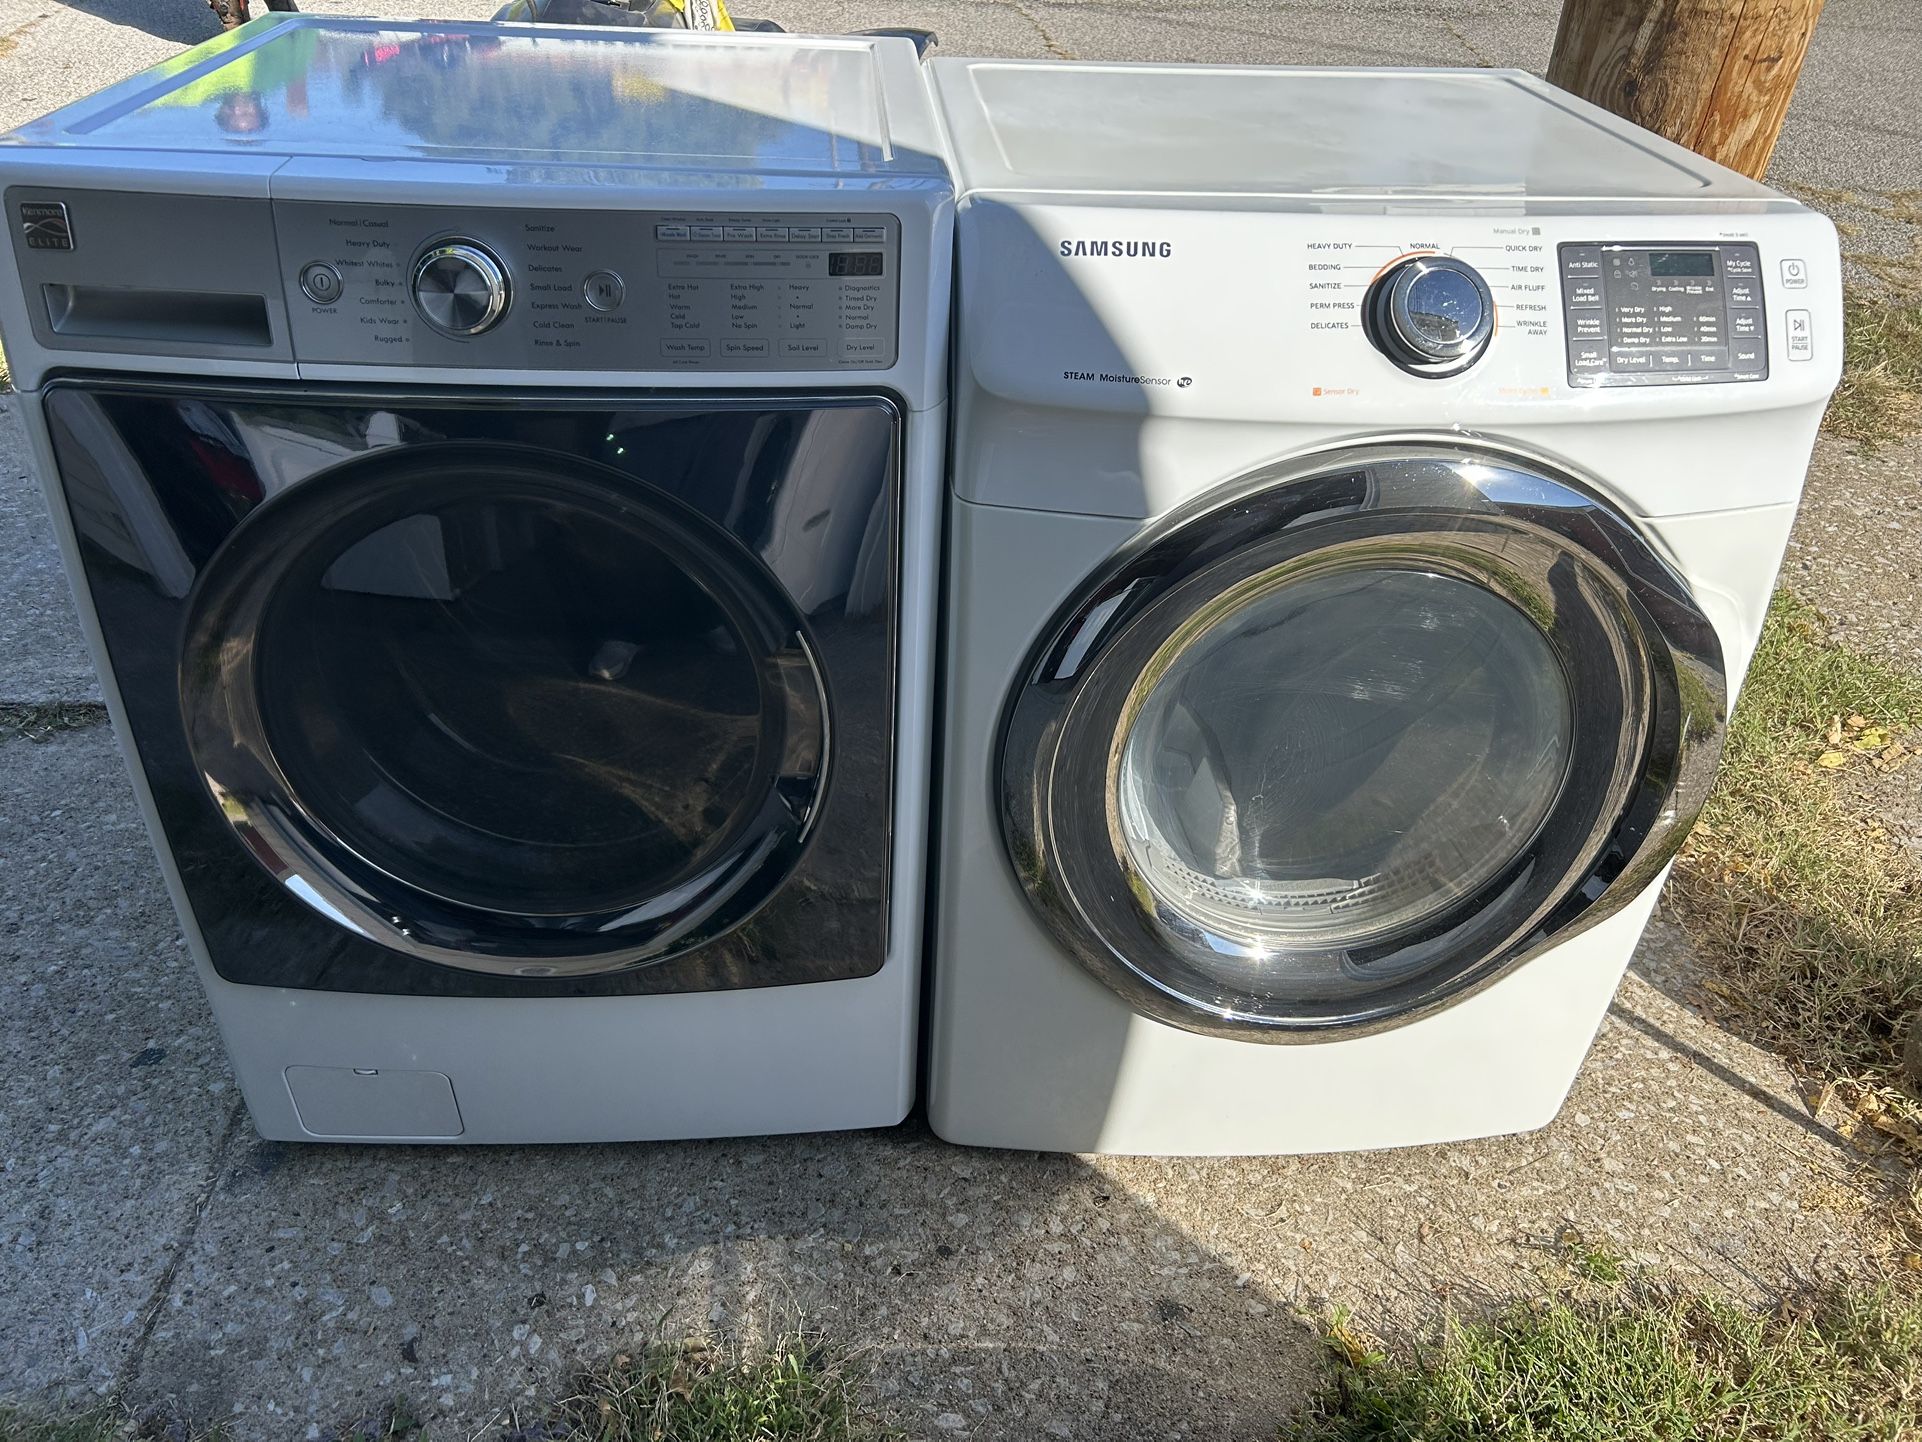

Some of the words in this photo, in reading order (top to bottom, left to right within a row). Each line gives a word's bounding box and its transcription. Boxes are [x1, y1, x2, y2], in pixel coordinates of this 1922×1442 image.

[525, 224, 556, 232] Sanitize
[1519, 228, 1530, 236] Dry
[28, 236, 69, 247] ELITE
[346, 239, 370, 248] Heavy
[372, 240, 390, 248] Duty
[527, 243, 560, 252] Workout
[562, 244, 582, 252] Wear
[1060, 240, 1172, 258] SAMSUNG
[367, 260, 393, 268] Whites
[528, 264, 562, 272] Delicates
[376, 279, 395, 287] Bulky
[1309, 282, 1342, 290] SANITIZE
[530, 283, 552, 292] Small
[554, 284, 572, 292] Load
[749, 284, 764, 292] High
[789, 284, 810, 292] Heavy
[844, 284, 880, 292] Diagnostics
[360, 296, 396, 305] Comforter
[730, 294, 746, 302] High
[866, 295, 877, 303] Dry
[1588, 294, 1600, 302] Bell
[531, 302, 559, 310] Express
[561, 302, 582, 310] Wash
[863, 304, 874, 312] Dry
[1310, 302, 1331, 310] PERM
[1620, 306, 1634, 314] Very
[1634, 306, 1644, 314] Dry
[670, 312, 686, 320] Cold
[1622, 316, 1636, 324] More
[1636, 316, 1646, 324] Dry
[533, 320, 551, 329] Cold
[552, 321, 575, 329] Clean
[744, 322, 758, 330] Spin
[790, 322, 806, 330] Light
[846, 322, 864, 330] Damp
[866, 322, 878, 330] Dry
[1310, 322, 1349, 330] DELICATES
[1578, 326, 1600, 334] Prevent
[1642, 326, 1653, 334] Dry
[374, 335, 402, 344] Rugged
[534, 339, 553, 347] Rinse
[564, 340, 580, 348] Spin
[666, 344, 686, 352] Wash
[688, 344, 706, 352] Temp
[726, 344, 741, 352] Spin
[742, 344, 764, 353] Speed
[788, 344, 800, 352] Soil
[802, 344, 819, 352] Level
[846, 344, 858, 352] Dry
[1616, 356, 1628, 364] Dry
[1738, 352, 1755, 360] Sound
[1063, 371, 1095, 381] STEAM
[1099, 372, 1171, 386] MoistureSensor
